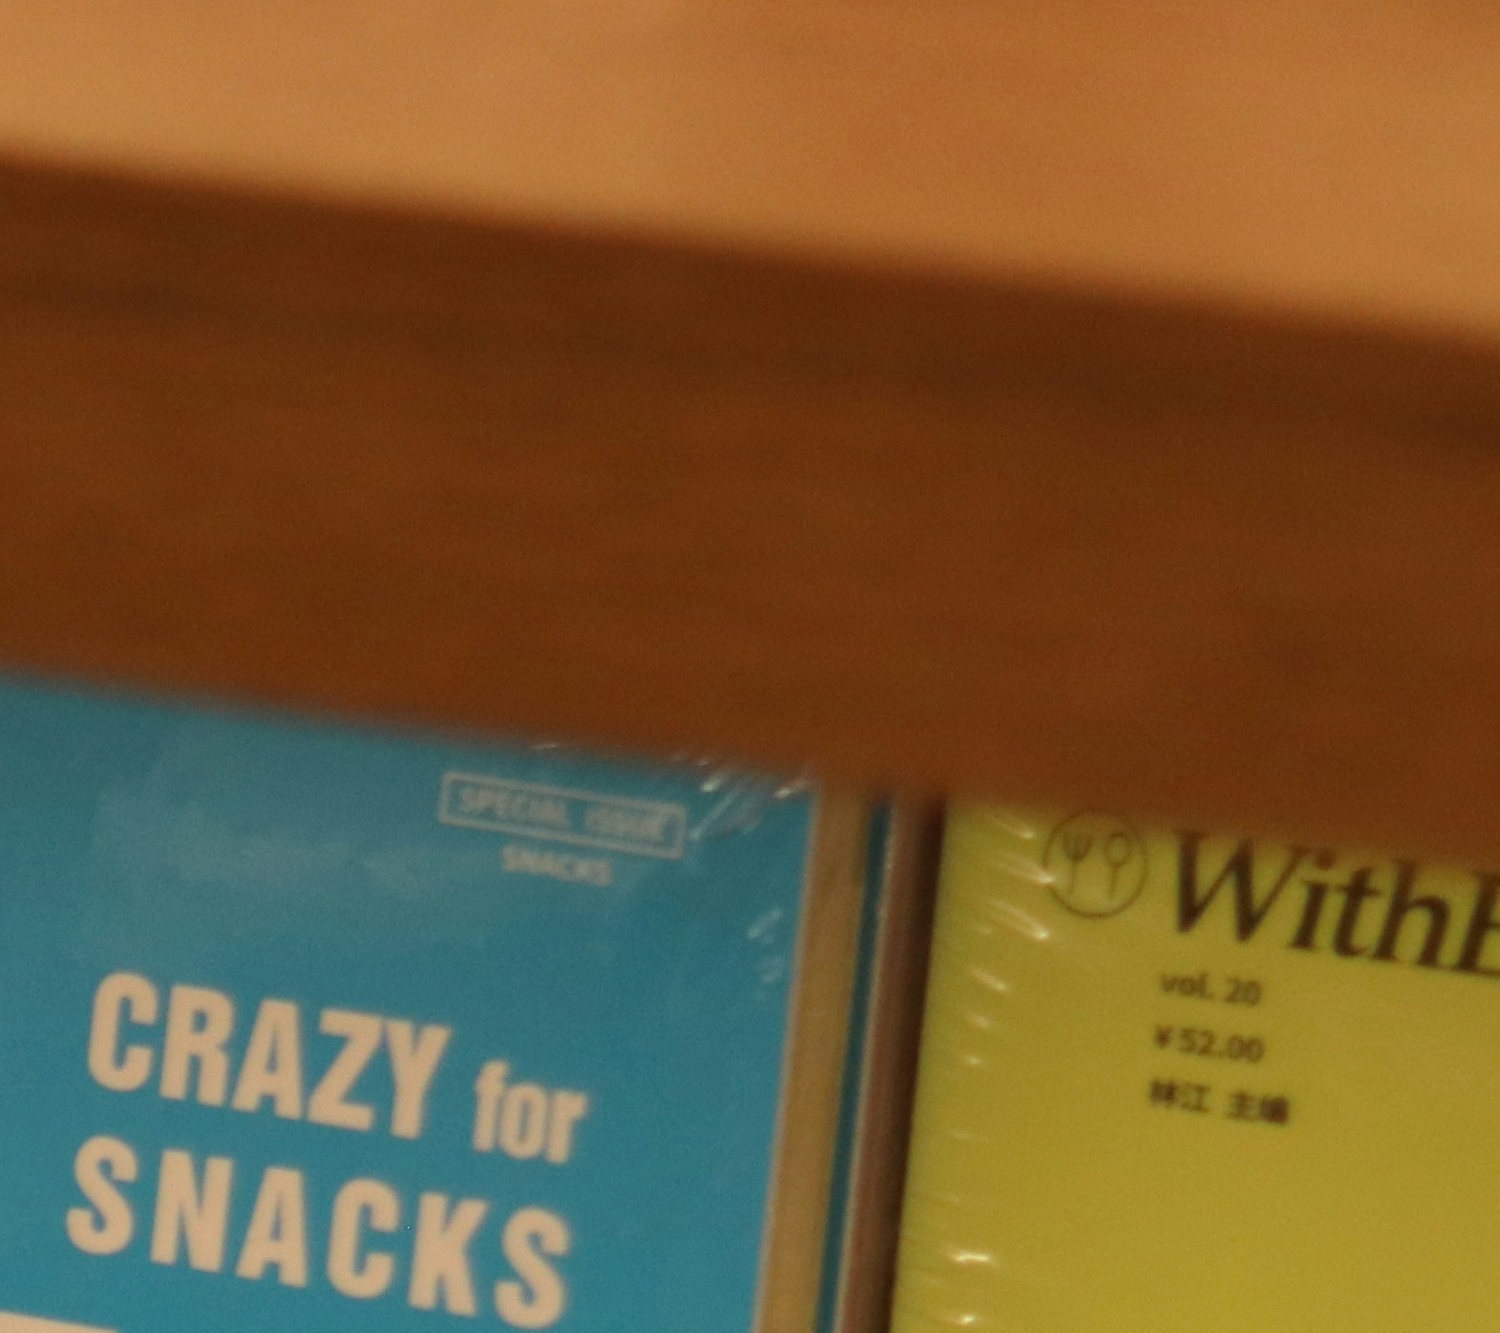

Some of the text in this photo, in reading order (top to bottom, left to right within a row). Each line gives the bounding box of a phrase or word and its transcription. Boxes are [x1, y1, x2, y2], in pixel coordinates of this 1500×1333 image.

[87, 970, 590, 1165] CRAZY for
[65, 1135, 573, 1330] SNACKS
